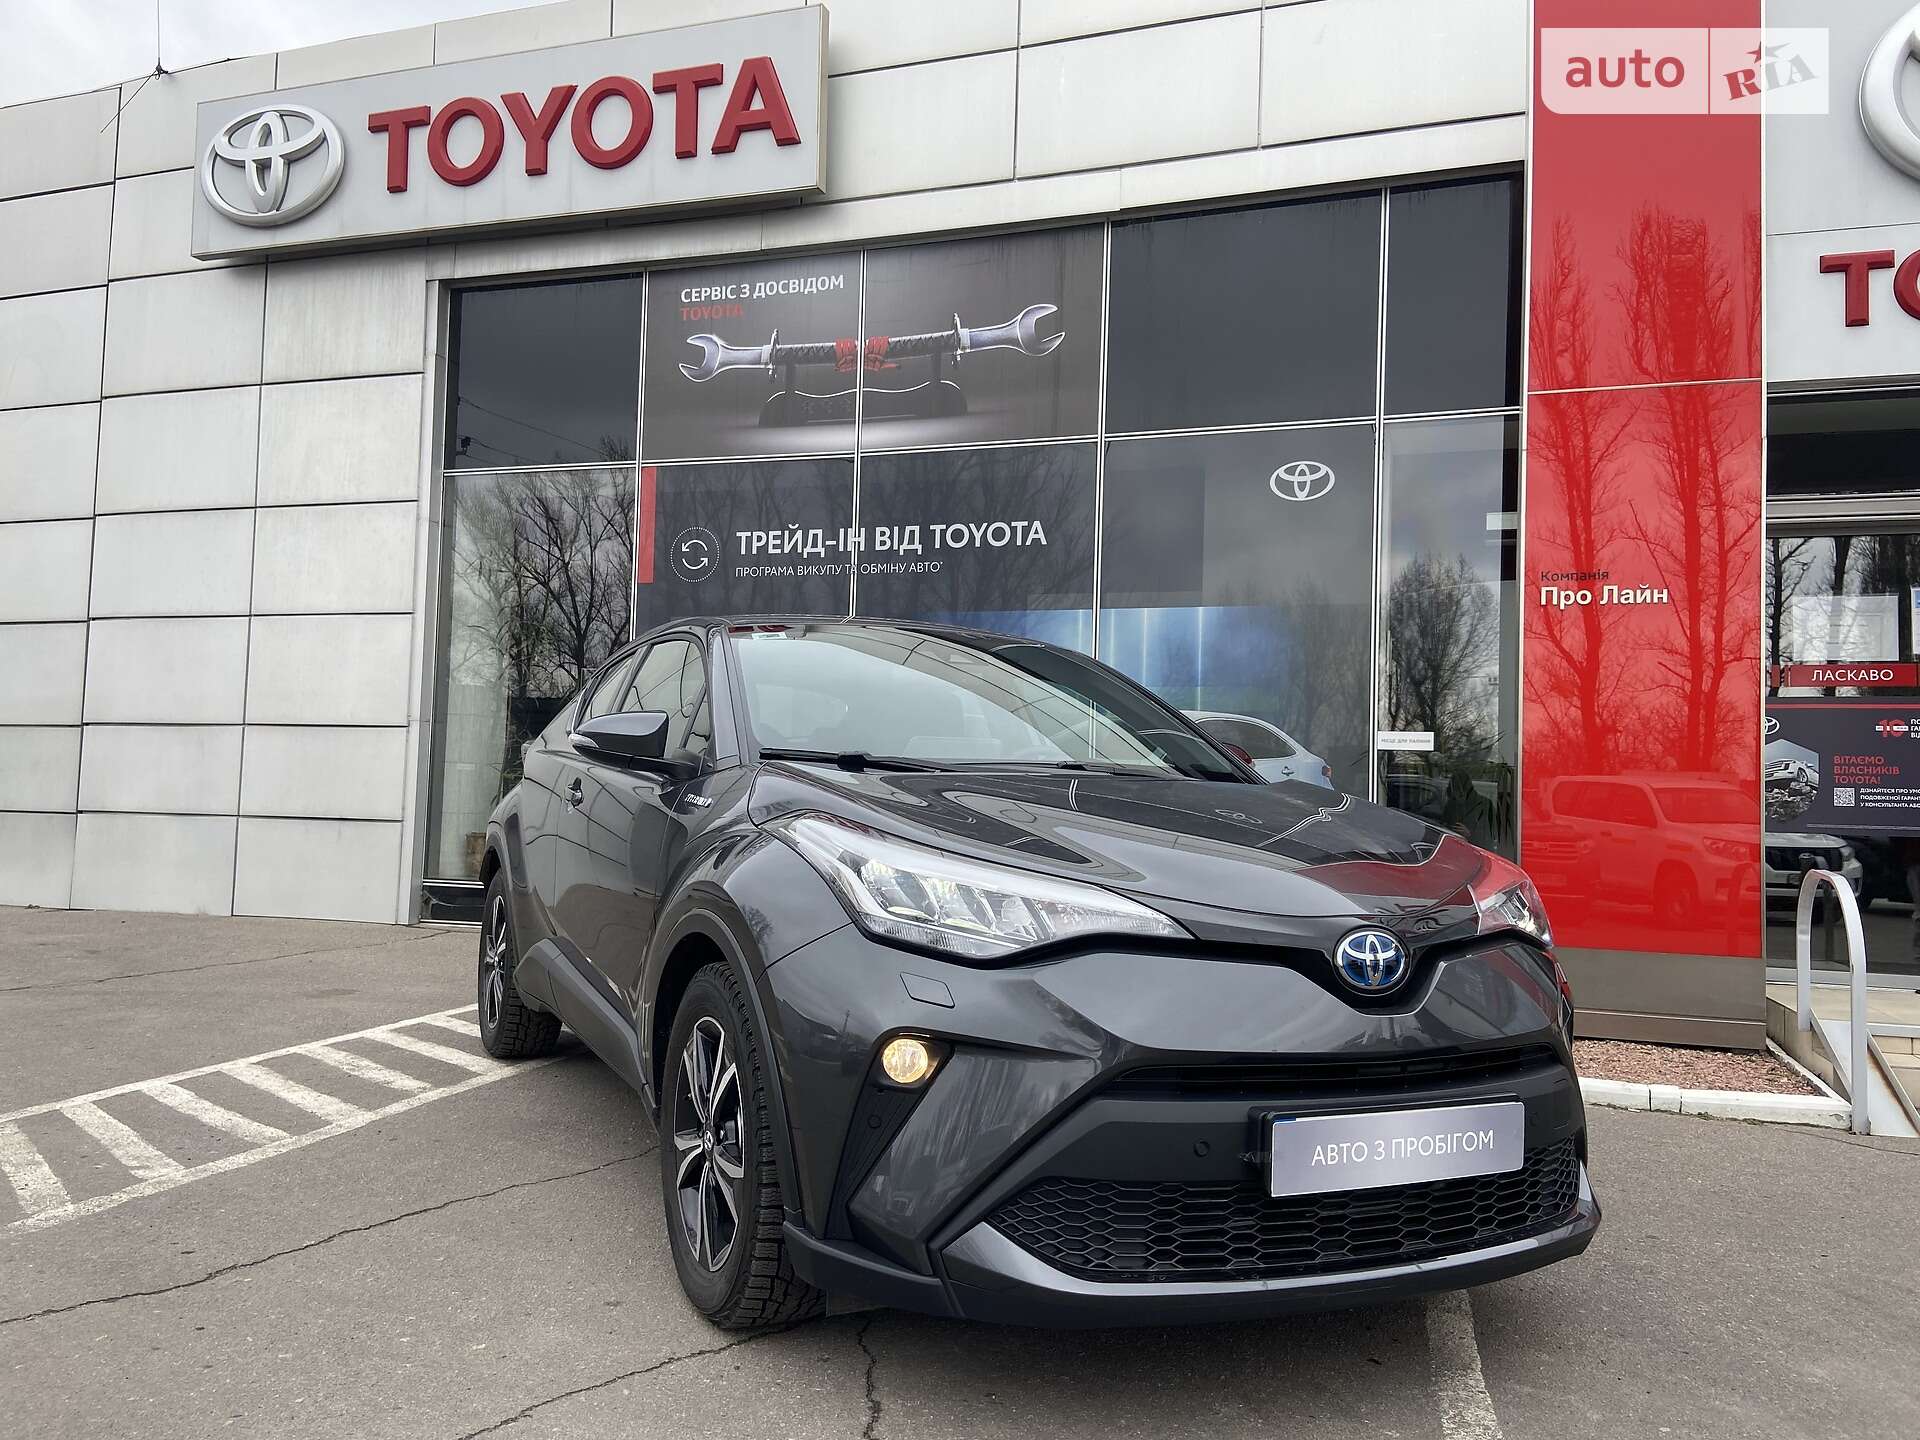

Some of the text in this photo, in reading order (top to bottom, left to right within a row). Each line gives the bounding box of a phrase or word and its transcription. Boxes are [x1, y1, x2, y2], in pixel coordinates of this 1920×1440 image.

[368, 56, 802, 193] TOYOTA
[681, 285, 737, 303] СЕРВІС
[753, 275, 844, 299] ДОСВІДОМ
[680, 304, 744, 321] TOYOTA
[736, 520, 1048, 559] ТРЕЙД-ІН ВІД TOYOTA
[735, 564, 795, 577] ПРОГРАМА
[797, 563, 842, 576] ВИКУПУ
[860, 562, 908, 575] ОБМІНУ
[1541, 569, 1609, 582] Компанія
[1540, 583, 1668, 610] Про Лайн
[1812, 669, 1894, 681] ЛАСКАВО
[1833, 755, 1884, 765] ВІТАЄМО
[1833, 766, 1900, 775] ВЛАСНИКІВ
[1833, 775, 1881, 785] TOYOTA!
[1311, 1141, 1368, 1166] АВТО
[1391, 1129, 1495, 1160] ПРОБІГОМ
